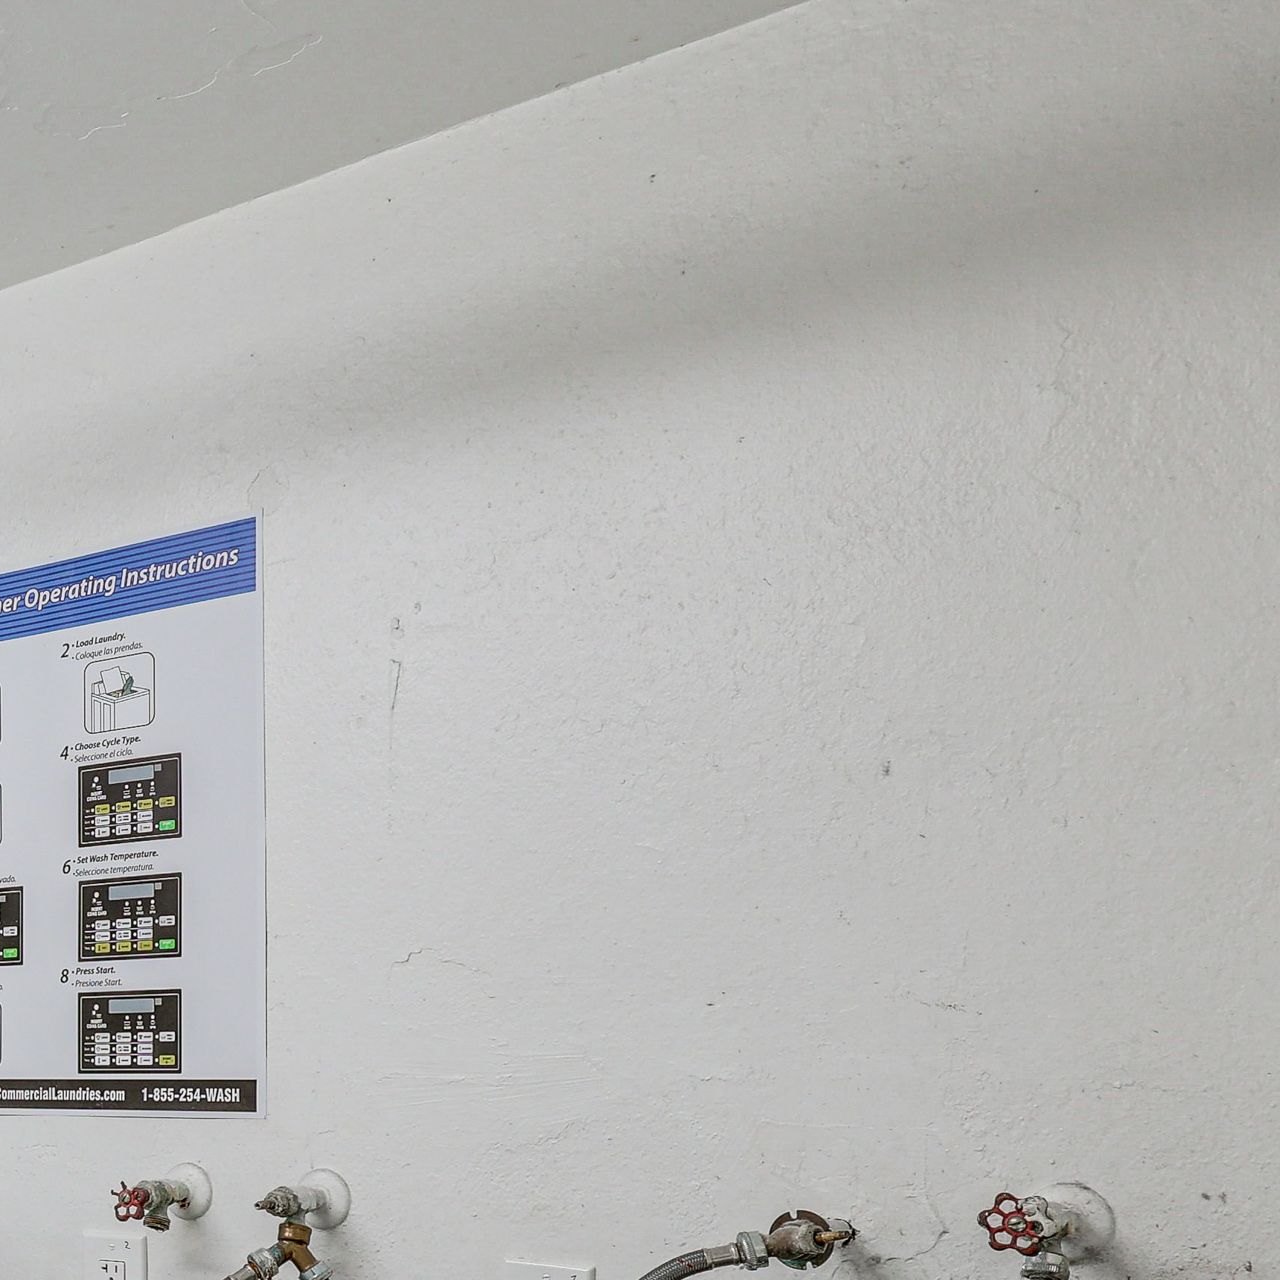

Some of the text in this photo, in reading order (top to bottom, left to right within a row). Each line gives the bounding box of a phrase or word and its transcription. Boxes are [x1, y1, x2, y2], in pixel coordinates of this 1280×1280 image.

[24, 575, 116, 612] Operating
[120, 547, 239, 588] Instructions
[75, 632, 125, 648] Load Laundry.
[60, 643, 70, 659] 2
[74, 736, 141, 750] Choose Cycle Type.
[60, 746, 69, 761] 4
[76, 851, 158, 864] Set Wash Temperature.
[62, 859, 71, 874] 6
[60, 968, 69, 983] 8
[75, 966, 115, 975] Press Start.
[142, 1087, 239, 1102] 1-855-254-WASH
